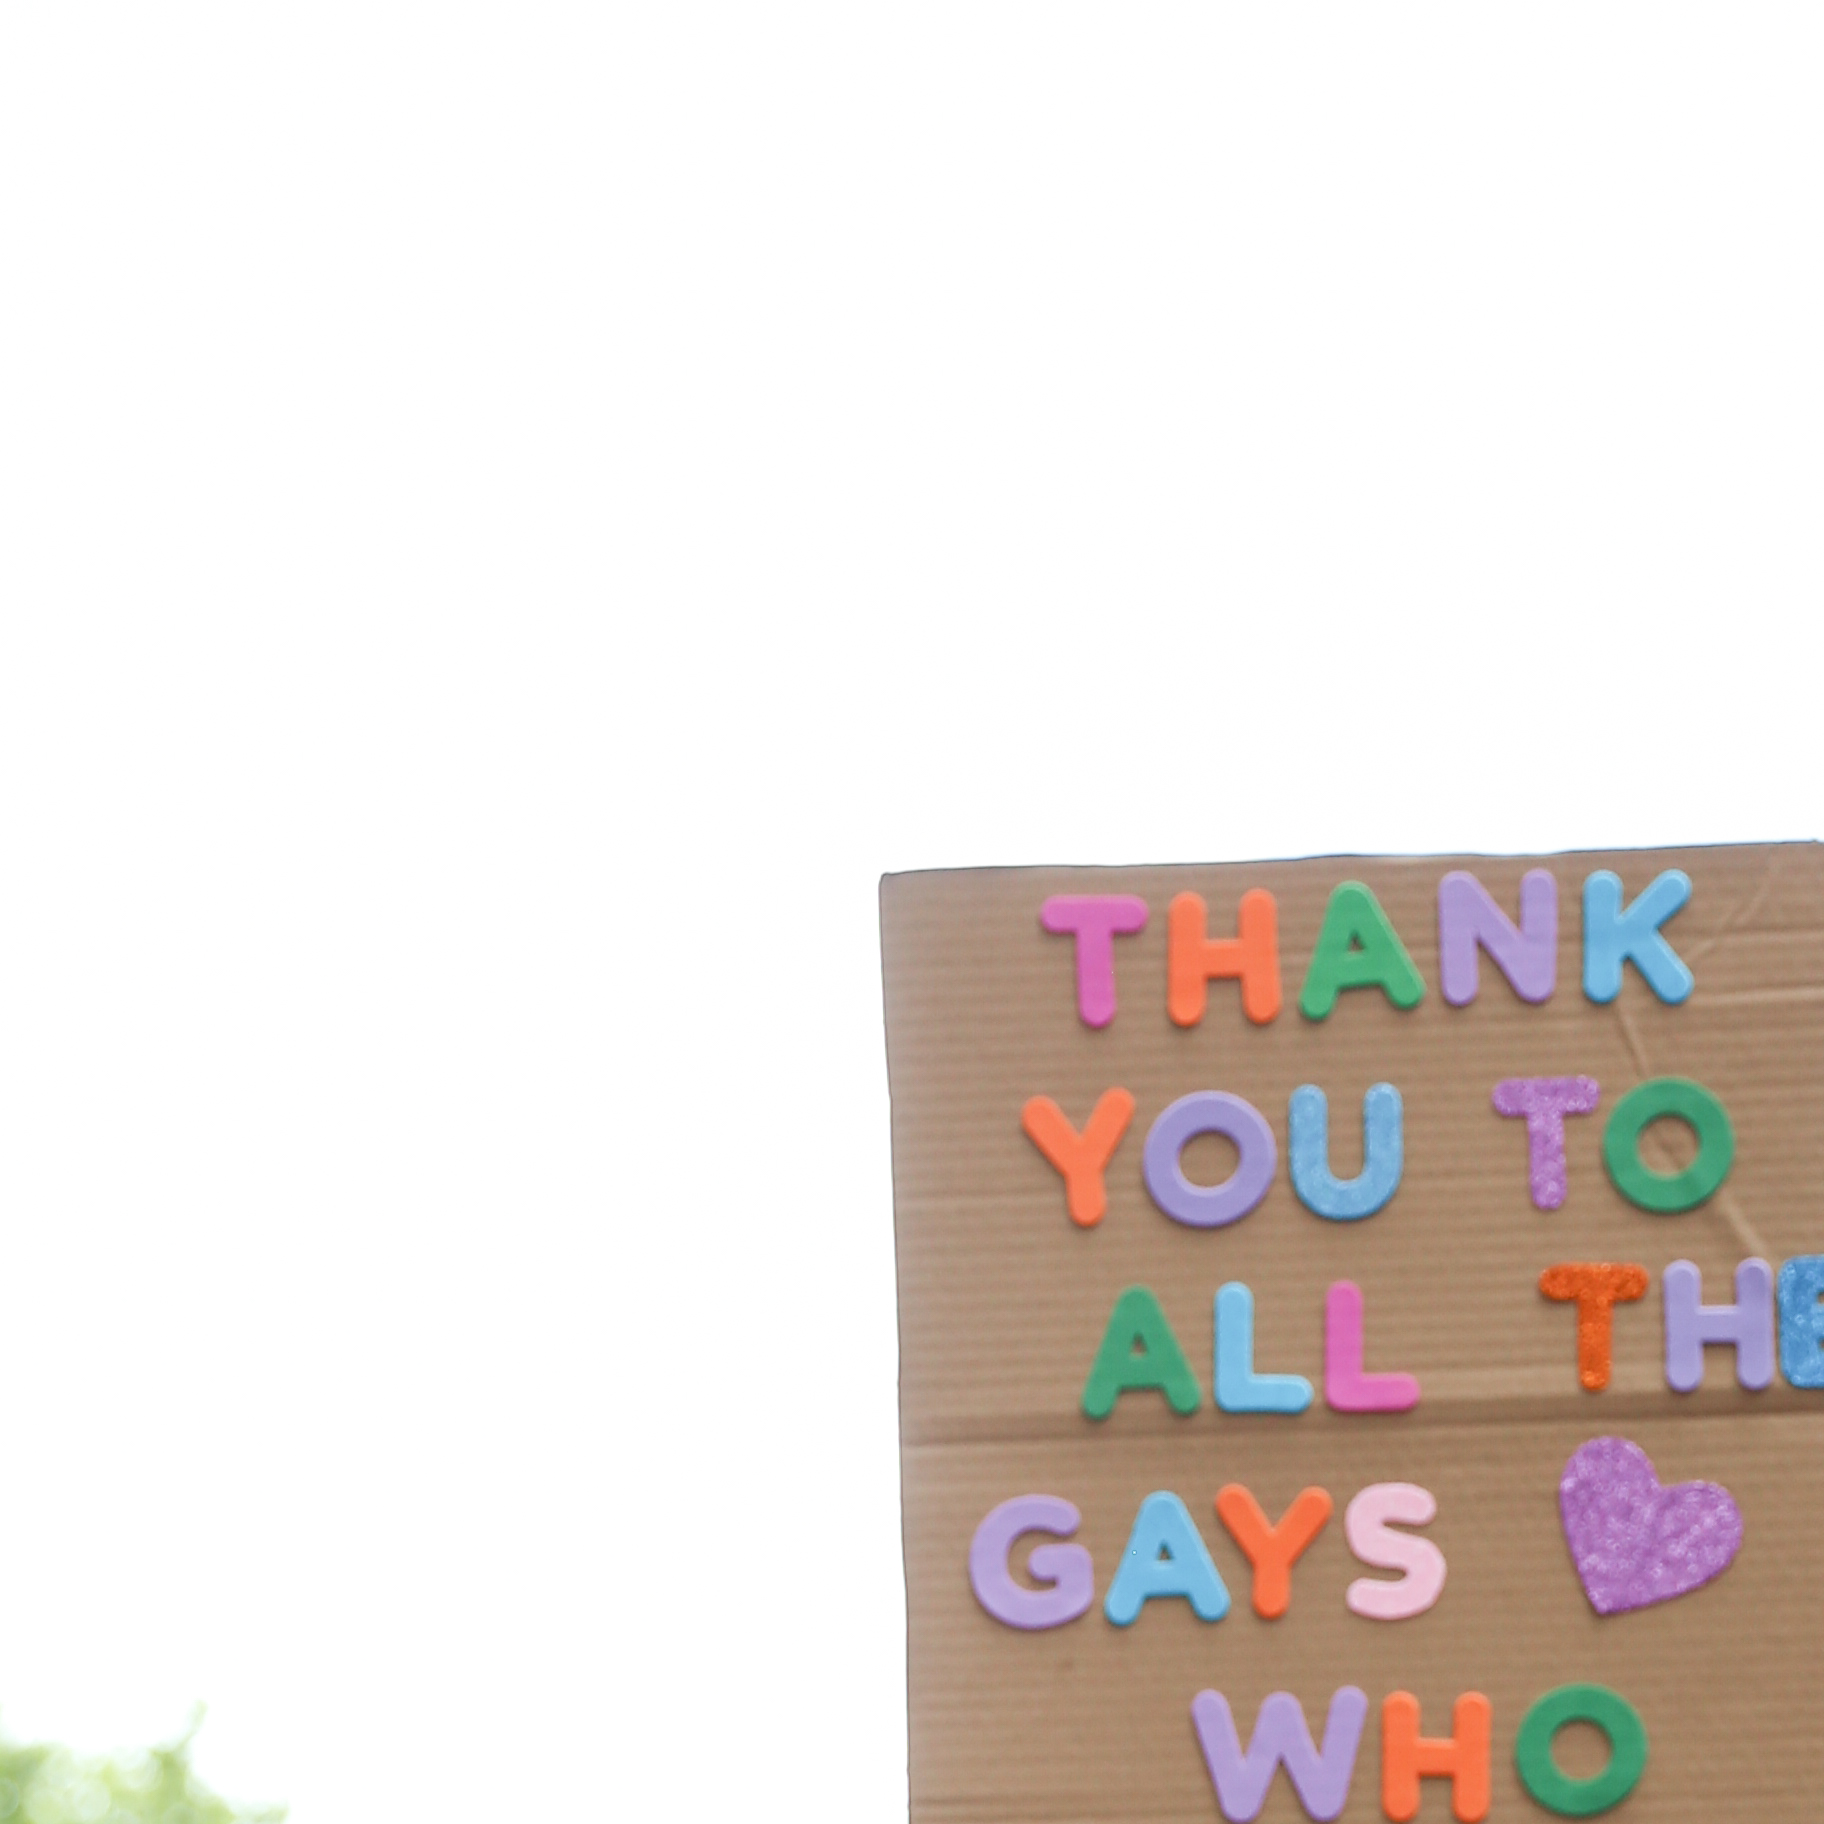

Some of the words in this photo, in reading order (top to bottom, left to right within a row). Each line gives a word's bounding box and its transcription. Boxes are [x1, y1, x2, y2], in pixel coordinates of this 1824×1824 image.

[1041, 868, 1694, 1028] THANK
[1022, 1082, 1401, 1228] YOU
[1492, 1075, 1736, 1214] TO
[1081, 1278, 1421, 1420] ALL
[969, 1481, 1447, 1629] GAYS
[1190, 1681, 1649, 1824] WHO
